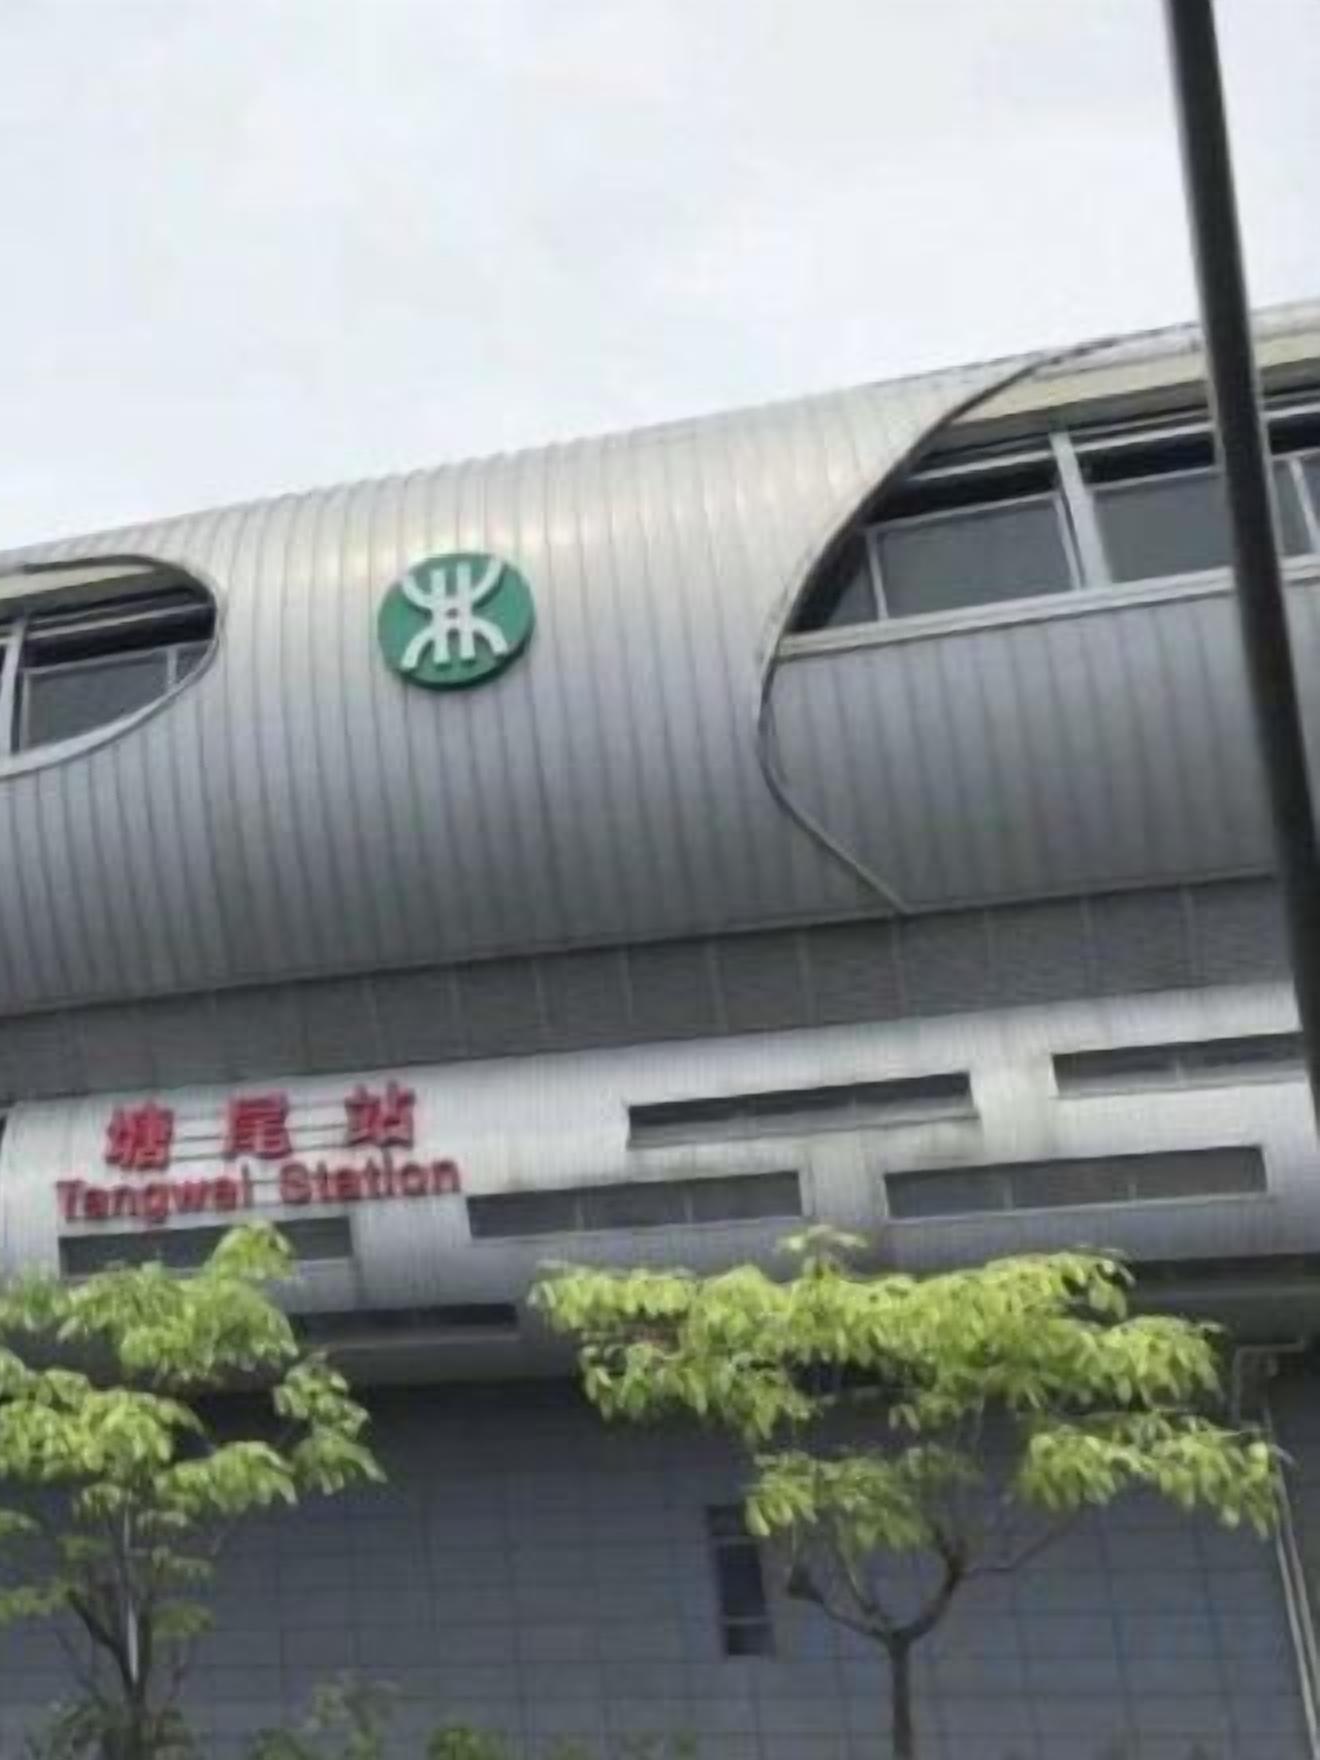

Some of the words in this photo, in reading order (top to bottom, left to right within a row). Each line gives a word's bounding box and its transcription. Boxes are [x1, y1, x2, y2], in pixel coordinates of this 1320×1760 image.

[105, 1081, 415, 1170] 塘尾站
[56, 1164, 254, 1223] Tangwei
[280, 1149, 461, 1204] Station
